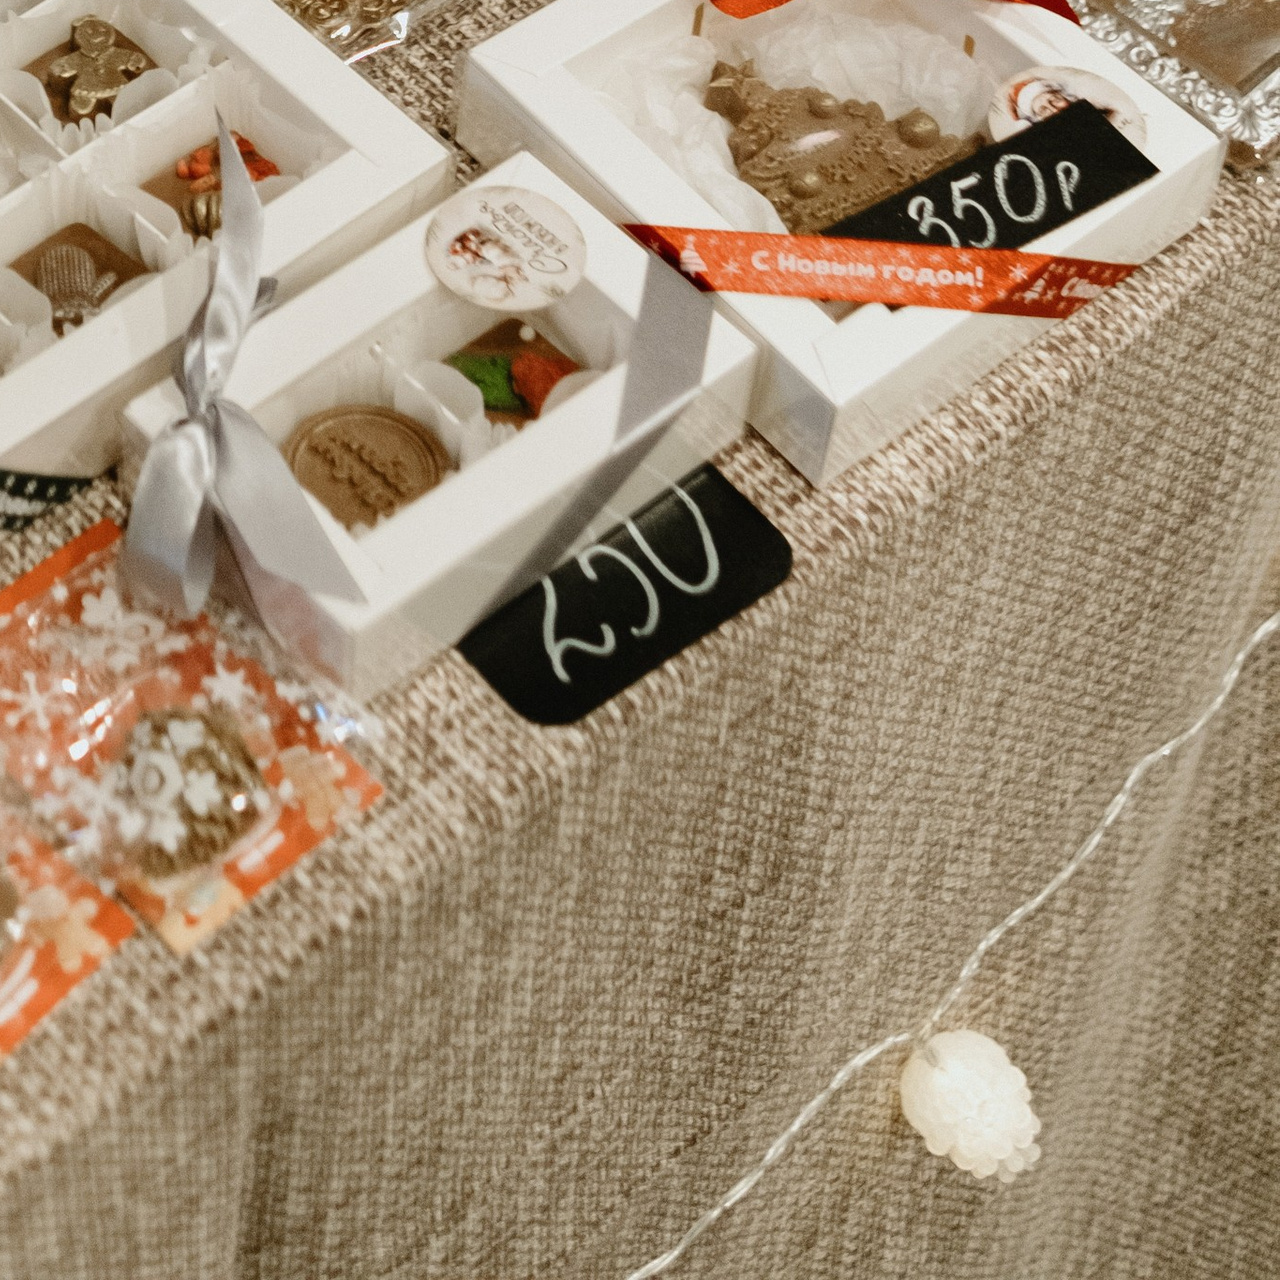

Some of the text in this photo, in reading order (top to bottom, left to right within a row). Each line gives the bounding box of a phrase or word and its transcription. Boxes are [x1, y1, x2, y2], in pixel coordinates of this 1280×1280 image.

[750, 250, 985, 289] С Новым годом!
